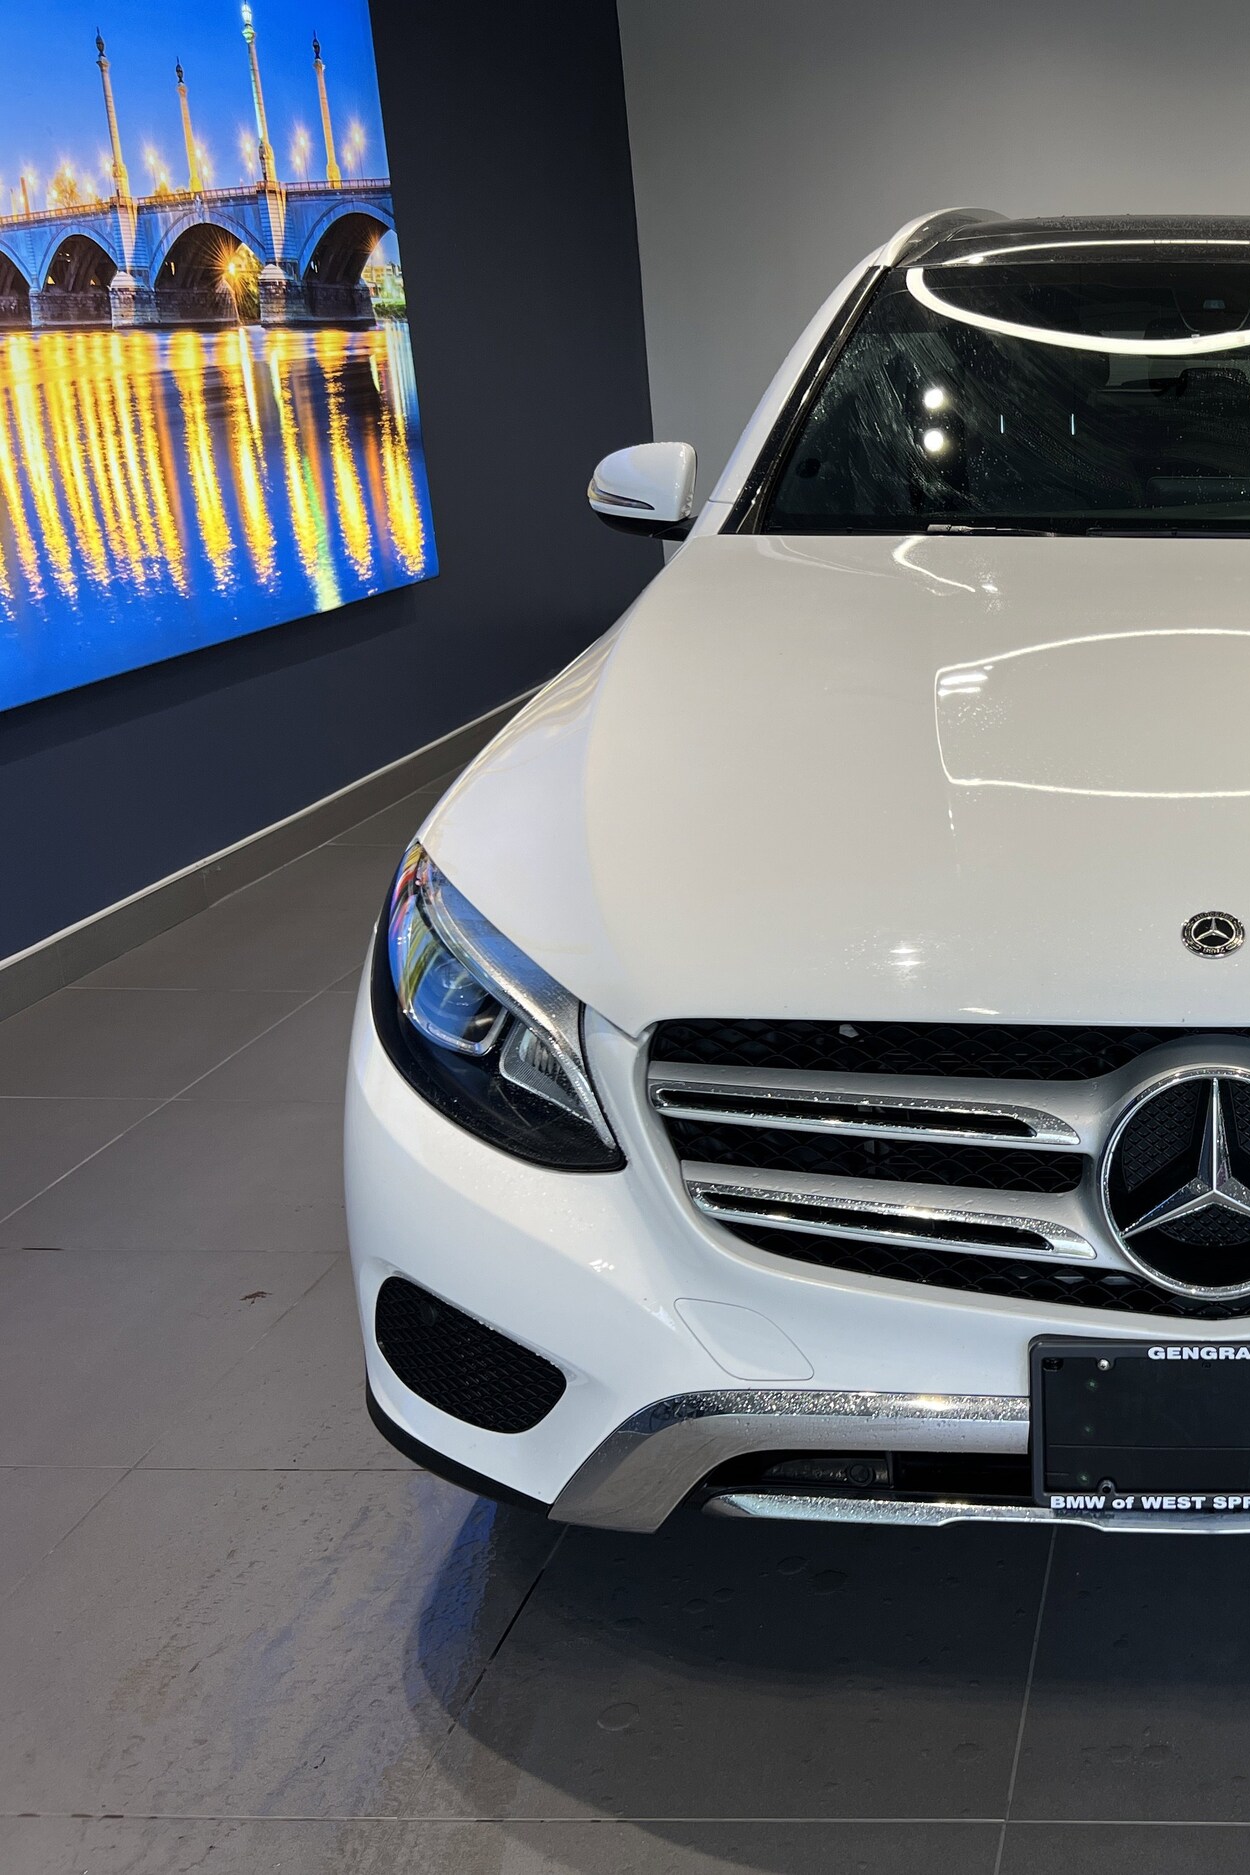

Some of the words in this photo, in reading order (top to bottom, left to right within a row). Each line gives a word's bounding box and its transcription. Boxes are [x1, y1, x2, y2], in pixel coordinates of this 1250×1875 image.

[1050, 1495, 1106, 1509] BMW
[1112, 1495, 1134, 1509] of
[1141, 1495, 1207, 1509] WEST
